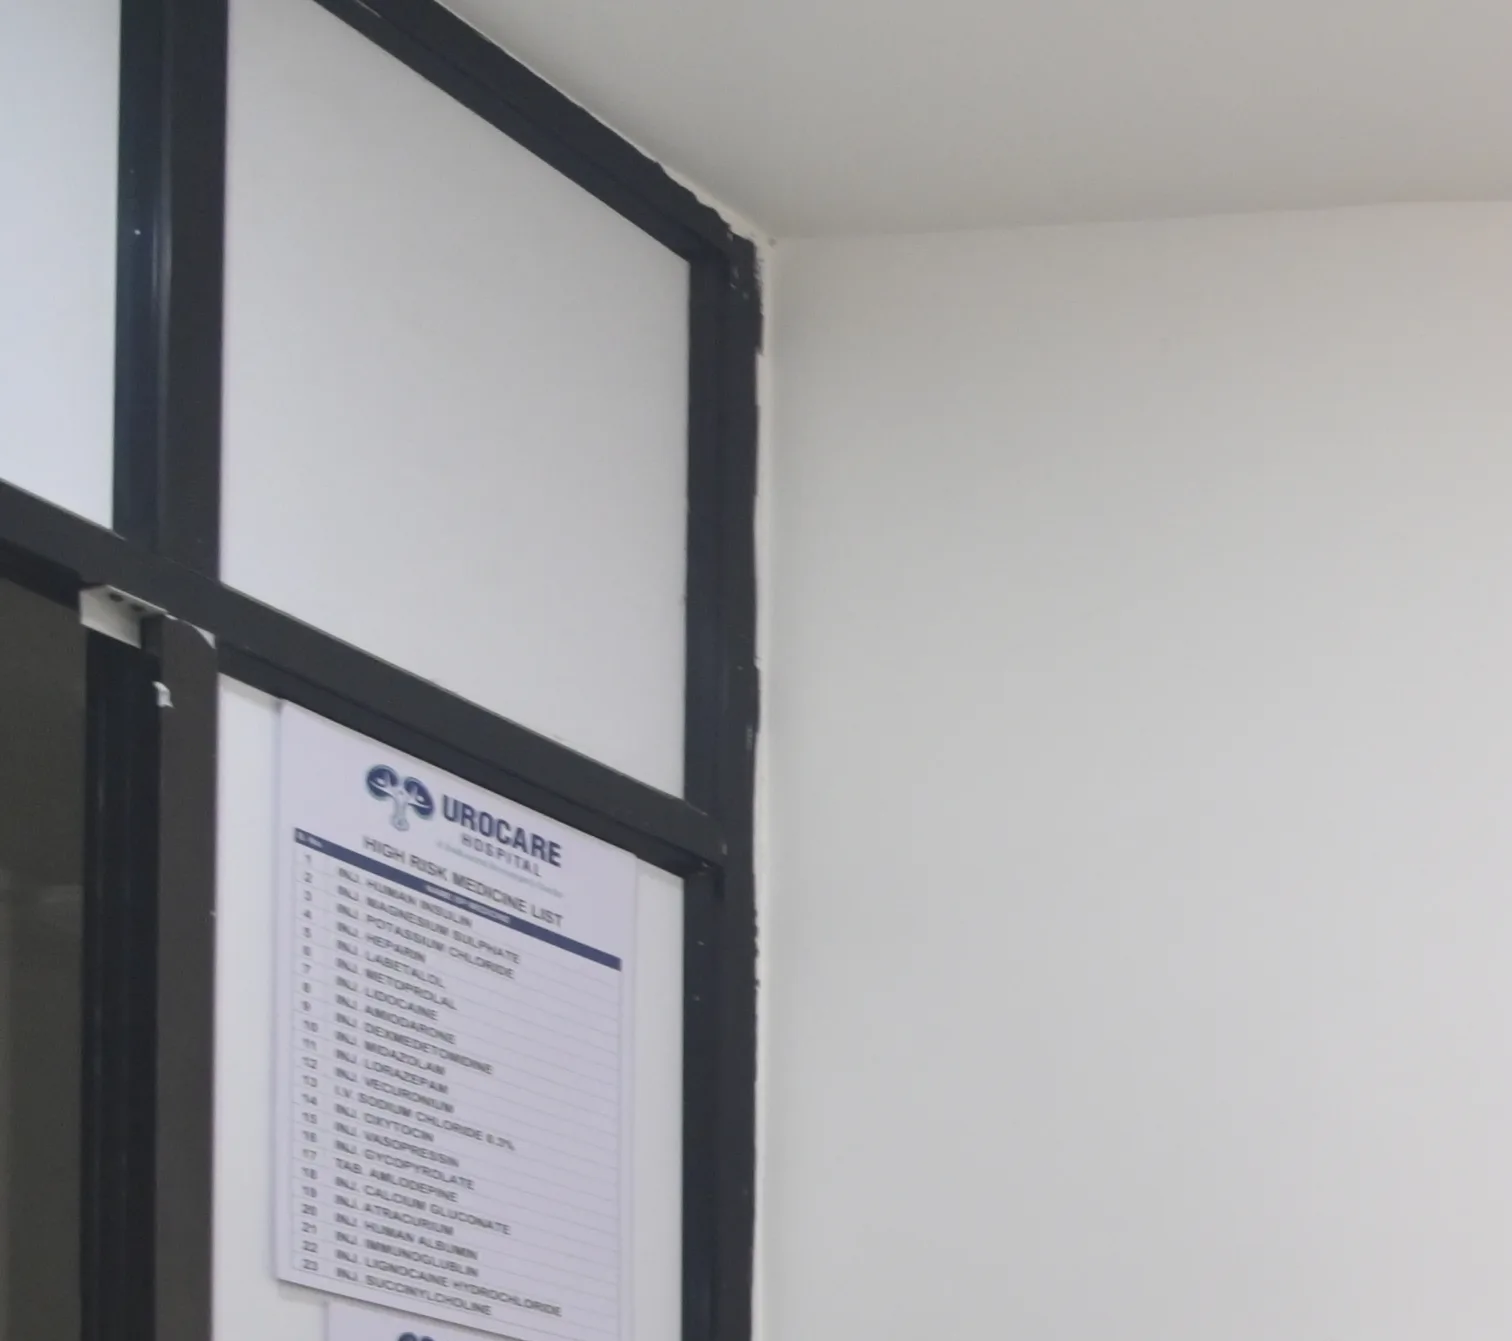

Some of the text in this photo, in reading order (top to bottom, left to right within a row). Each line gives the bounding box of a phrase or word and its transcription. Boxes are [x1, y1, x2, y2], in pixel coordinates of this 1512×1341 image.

[442, 795, 562, 868] UROCARE
[461, 833, 542, 877] HOSPITAL
[363, 836, 563, 927] HIGH RISK MEDICINE LIST
